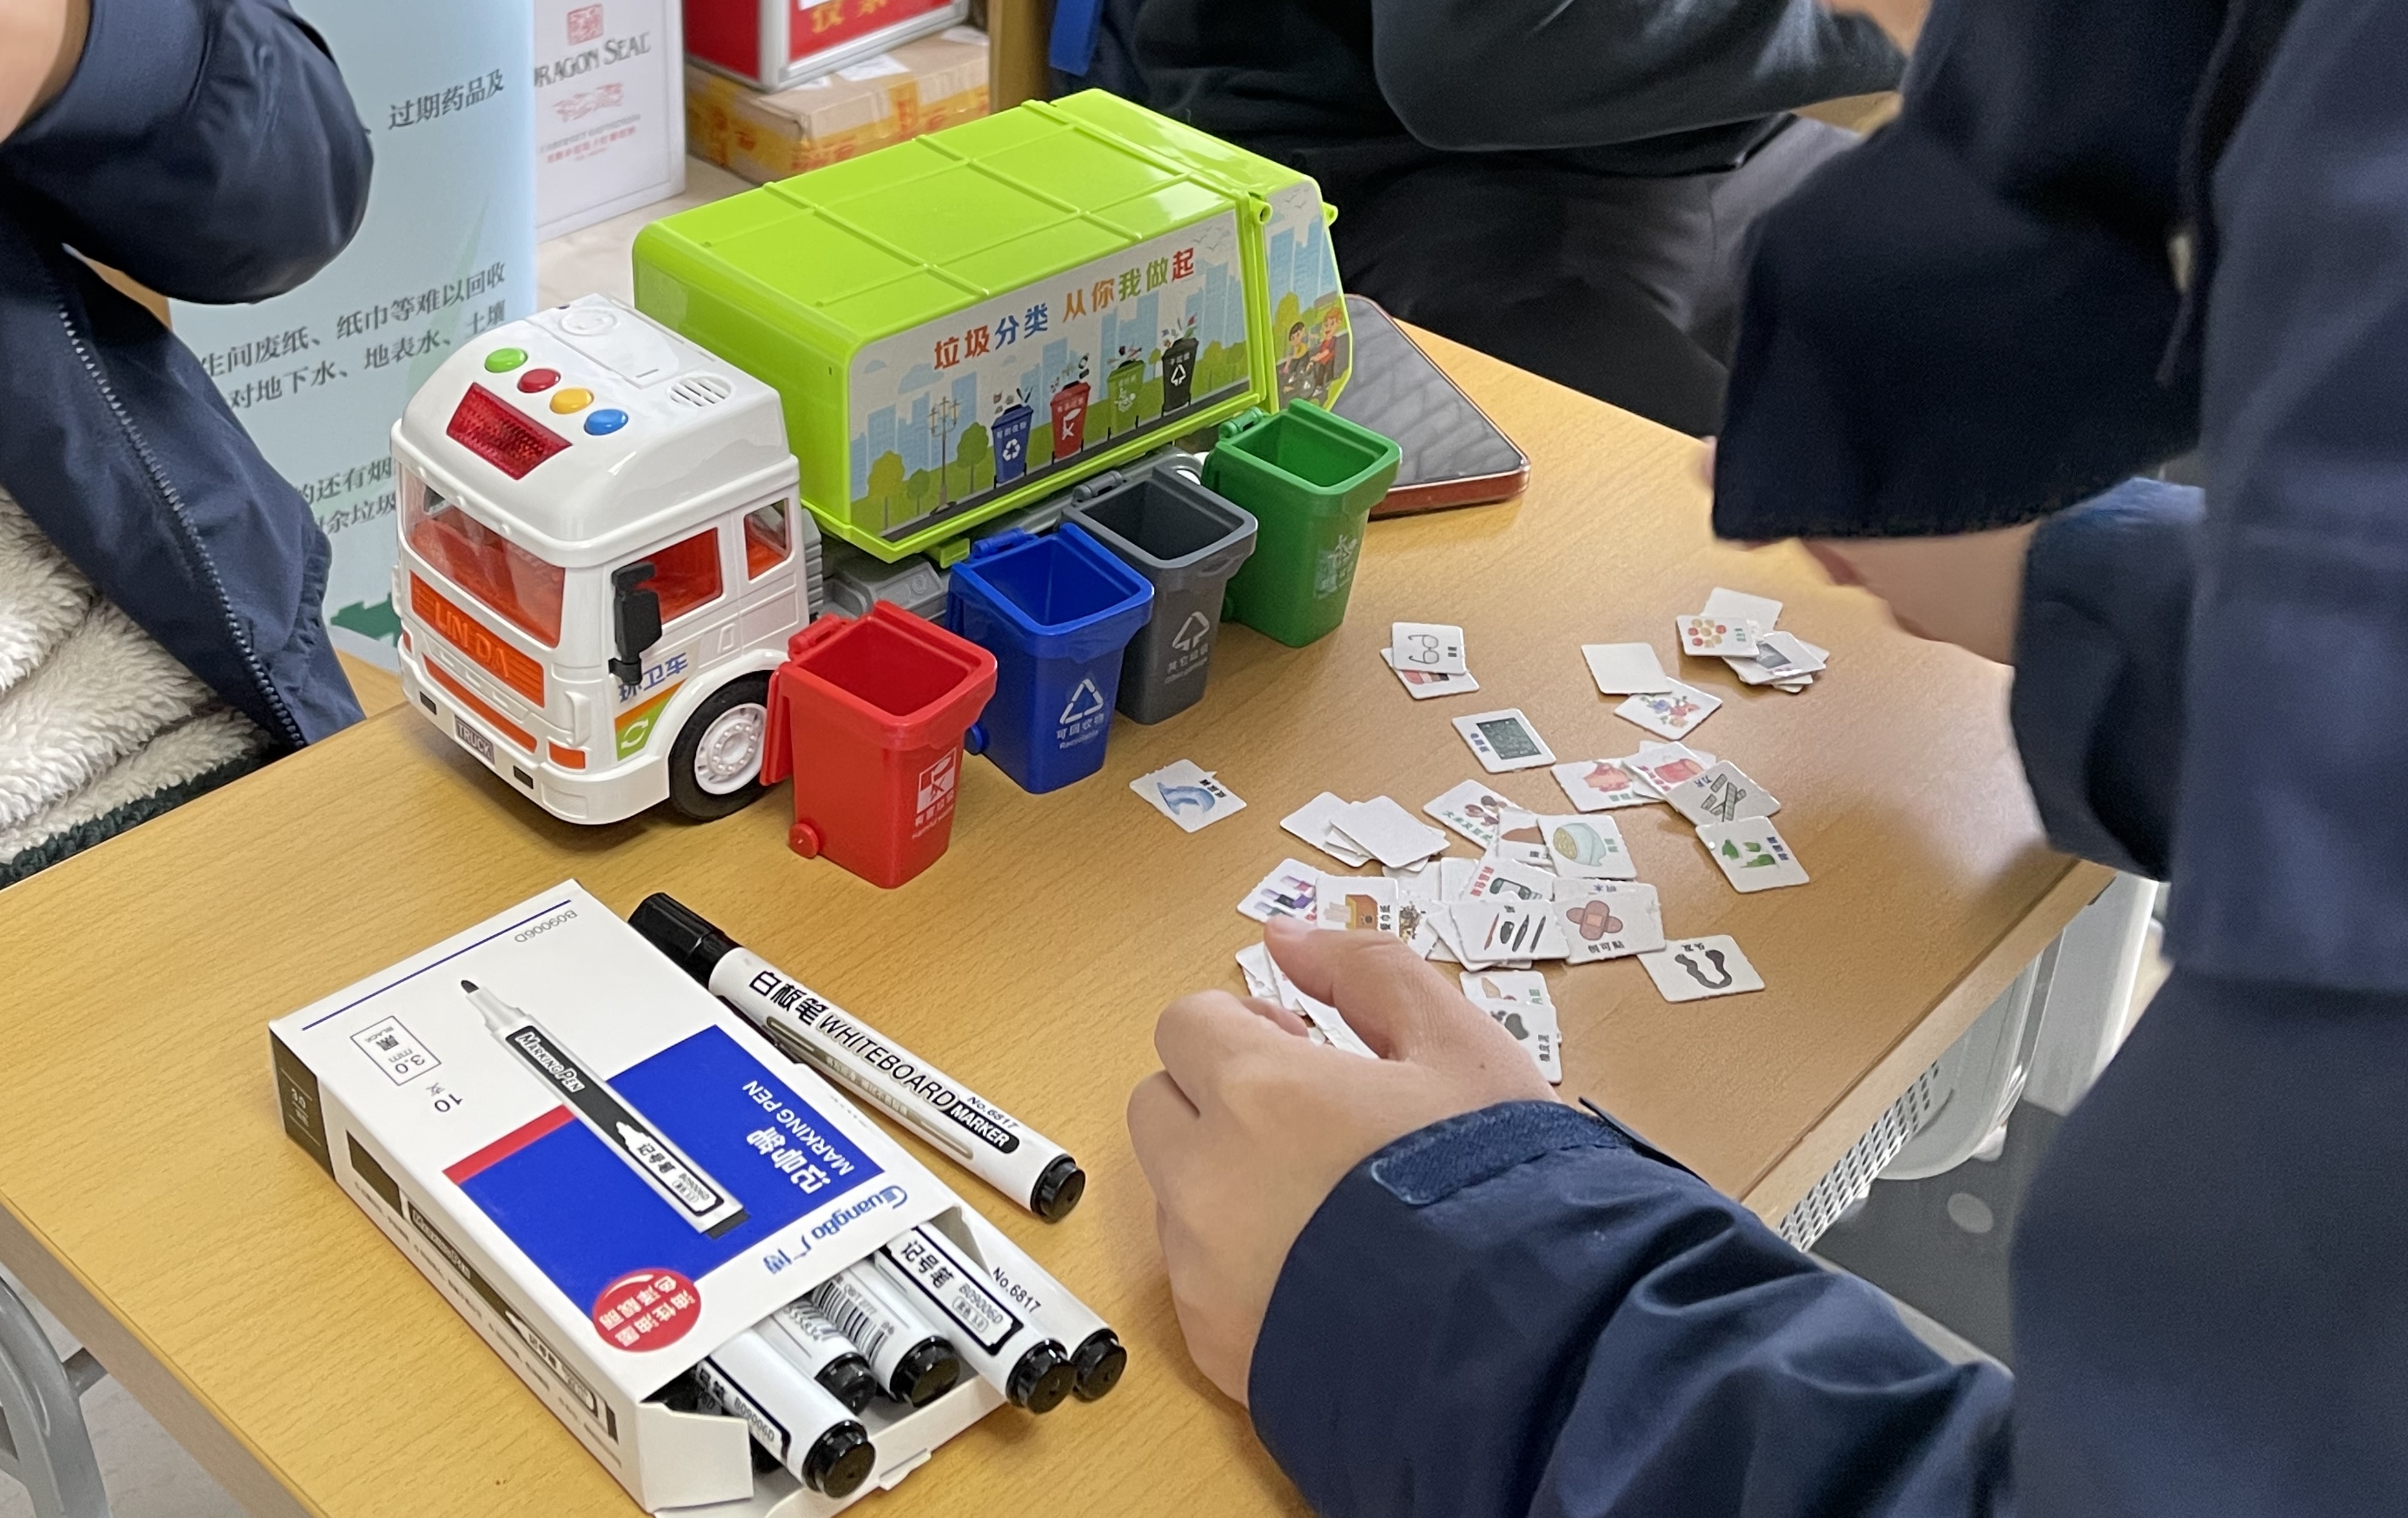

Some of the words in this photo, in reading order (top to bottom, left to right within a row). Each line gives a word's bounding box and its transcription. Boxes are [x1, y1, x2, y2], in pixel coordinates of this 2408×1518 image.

[602, 32, 651, 65] SEAL
[389, 69, 504, 130] 过期药品及
[934, 304, 1049, 370] 垃圾分类
[1062, 248, 1195, 323] 从你我做起
[457, 719, 493, 762] TRUCK
[1056, 713, 1105, 740] 可回收物
[514, 909, 578, 943] B09006D
[749, 970, 830, 1026] 白板笔
[375, 1035, 400, 1052] 黑
[388, 1048, 413, 1064] mm
[395, 1054, 426, 1074] 3.0
[425, 1082, 445, 1097] 支
[742, 1081, 783, 1112] PEN
[818, 1014, 957, 1107] WHITEBOARD
[950, 1104, 1010, 1148] MARKER
[434, 1093, 463, 1113] 10
[967, 1097, 1019, 1129] No.6817
[746, 1126, 831, 1194] 记号笔
[776, 1108, 855, 1175] MARKING
[900, 1240, 955, 1289] 记号笔
[599, 1275, 677, 1331] 色泽靓丽
[993, 1267, 1041, 1313] No.6817
[615, 1288, 696, 1347] 油性油墨
